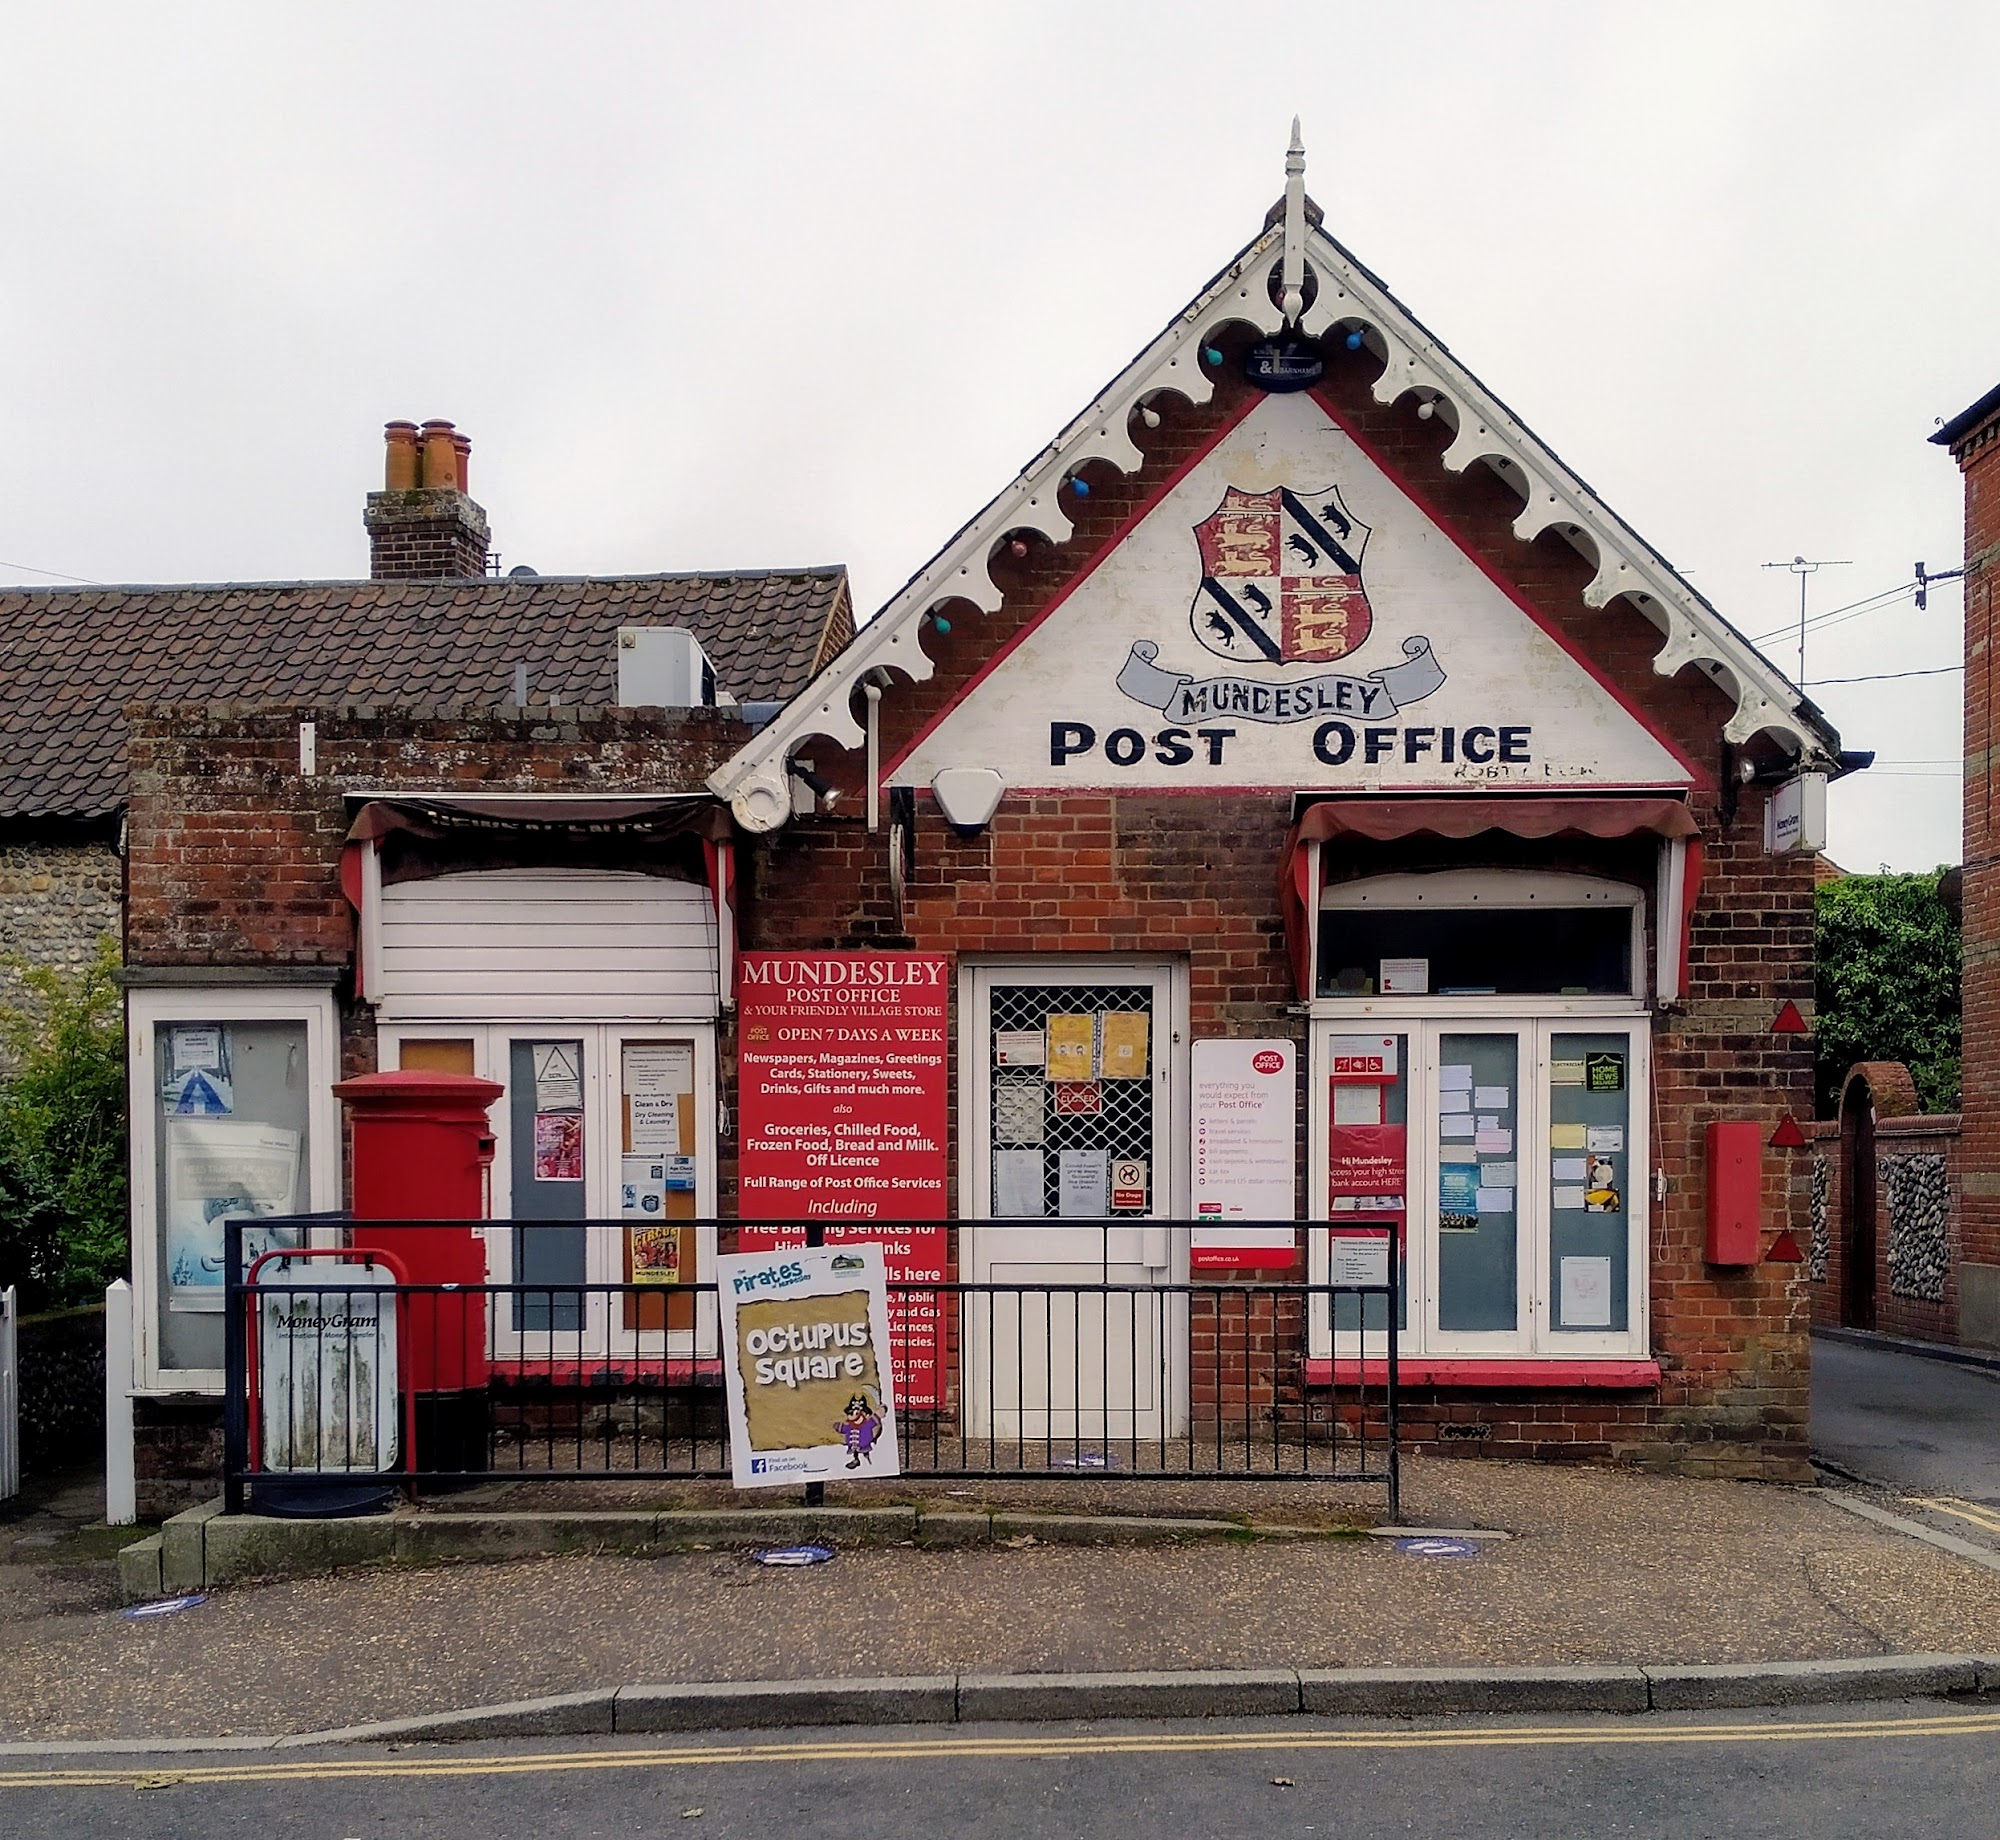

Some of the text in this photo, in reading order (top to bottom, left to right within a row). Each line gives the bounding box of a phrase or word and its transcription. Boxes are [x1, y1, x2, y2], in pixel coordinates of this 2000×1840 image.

[1181, 683, 1381, 716] MUNDESLEY
[1050, 720, 1532, 766] POST OFFICE
[742, 960, 945, 986] MUNDESLEY
[786, 988, 901, 1003] POST OFFICE
[744, 1006, 942, 1016] & YOUR FRIENDLY VILLAGE STORE
[778, 1028, 943, 1042] OPEN 7 DAYS A WEEK
[744, 1052, 942, 1065] Newspapers, Magazines, Greetings
[1255, 1062, 1281, 1070] OFFICE
[770, 1068, 916, 1081] Cards, Stationery, Sweets,
[760, 1083, 925, 1095] Drinks, Gifts and much more.
[1199, 1082, 1239, 1090] everything
[1061, 1095, 1095, 1103] CLOSED
[1199, 1091, 1269, 1100] would expect from
[833, 1104, 853, 1114] also
[1199, 1102, 1216, 1110] your
[1218, 1101, 1236, 1109] Post
[764, 1123, 921, 1136] Groceries, Chilled Food,
[747, 1139, 939, 1152] Frozen Food, Bread and Milk.
[806, 1154, 880, 1166] Off Licence
[1342, 1157, 1393, 1167] Hi Mundesley
[1353, 1169, 1370, 1177] your
[1372, 1167, 1387, 1177] high
[744, 1177, 942, 1190] Full Range of Post Office Services
[1332, 1178, 1349, 1186] bank
[1351, 1179, 1379, 1187] account
[808, 1199, 878, 1217] Including
[732, 1262, 803, 1295] Pirates
[905, 1267, 941, 1281] here
[277, 1314, 377, 1331] MoneyGram
[769, 1461, 808, 1473] Facebook
